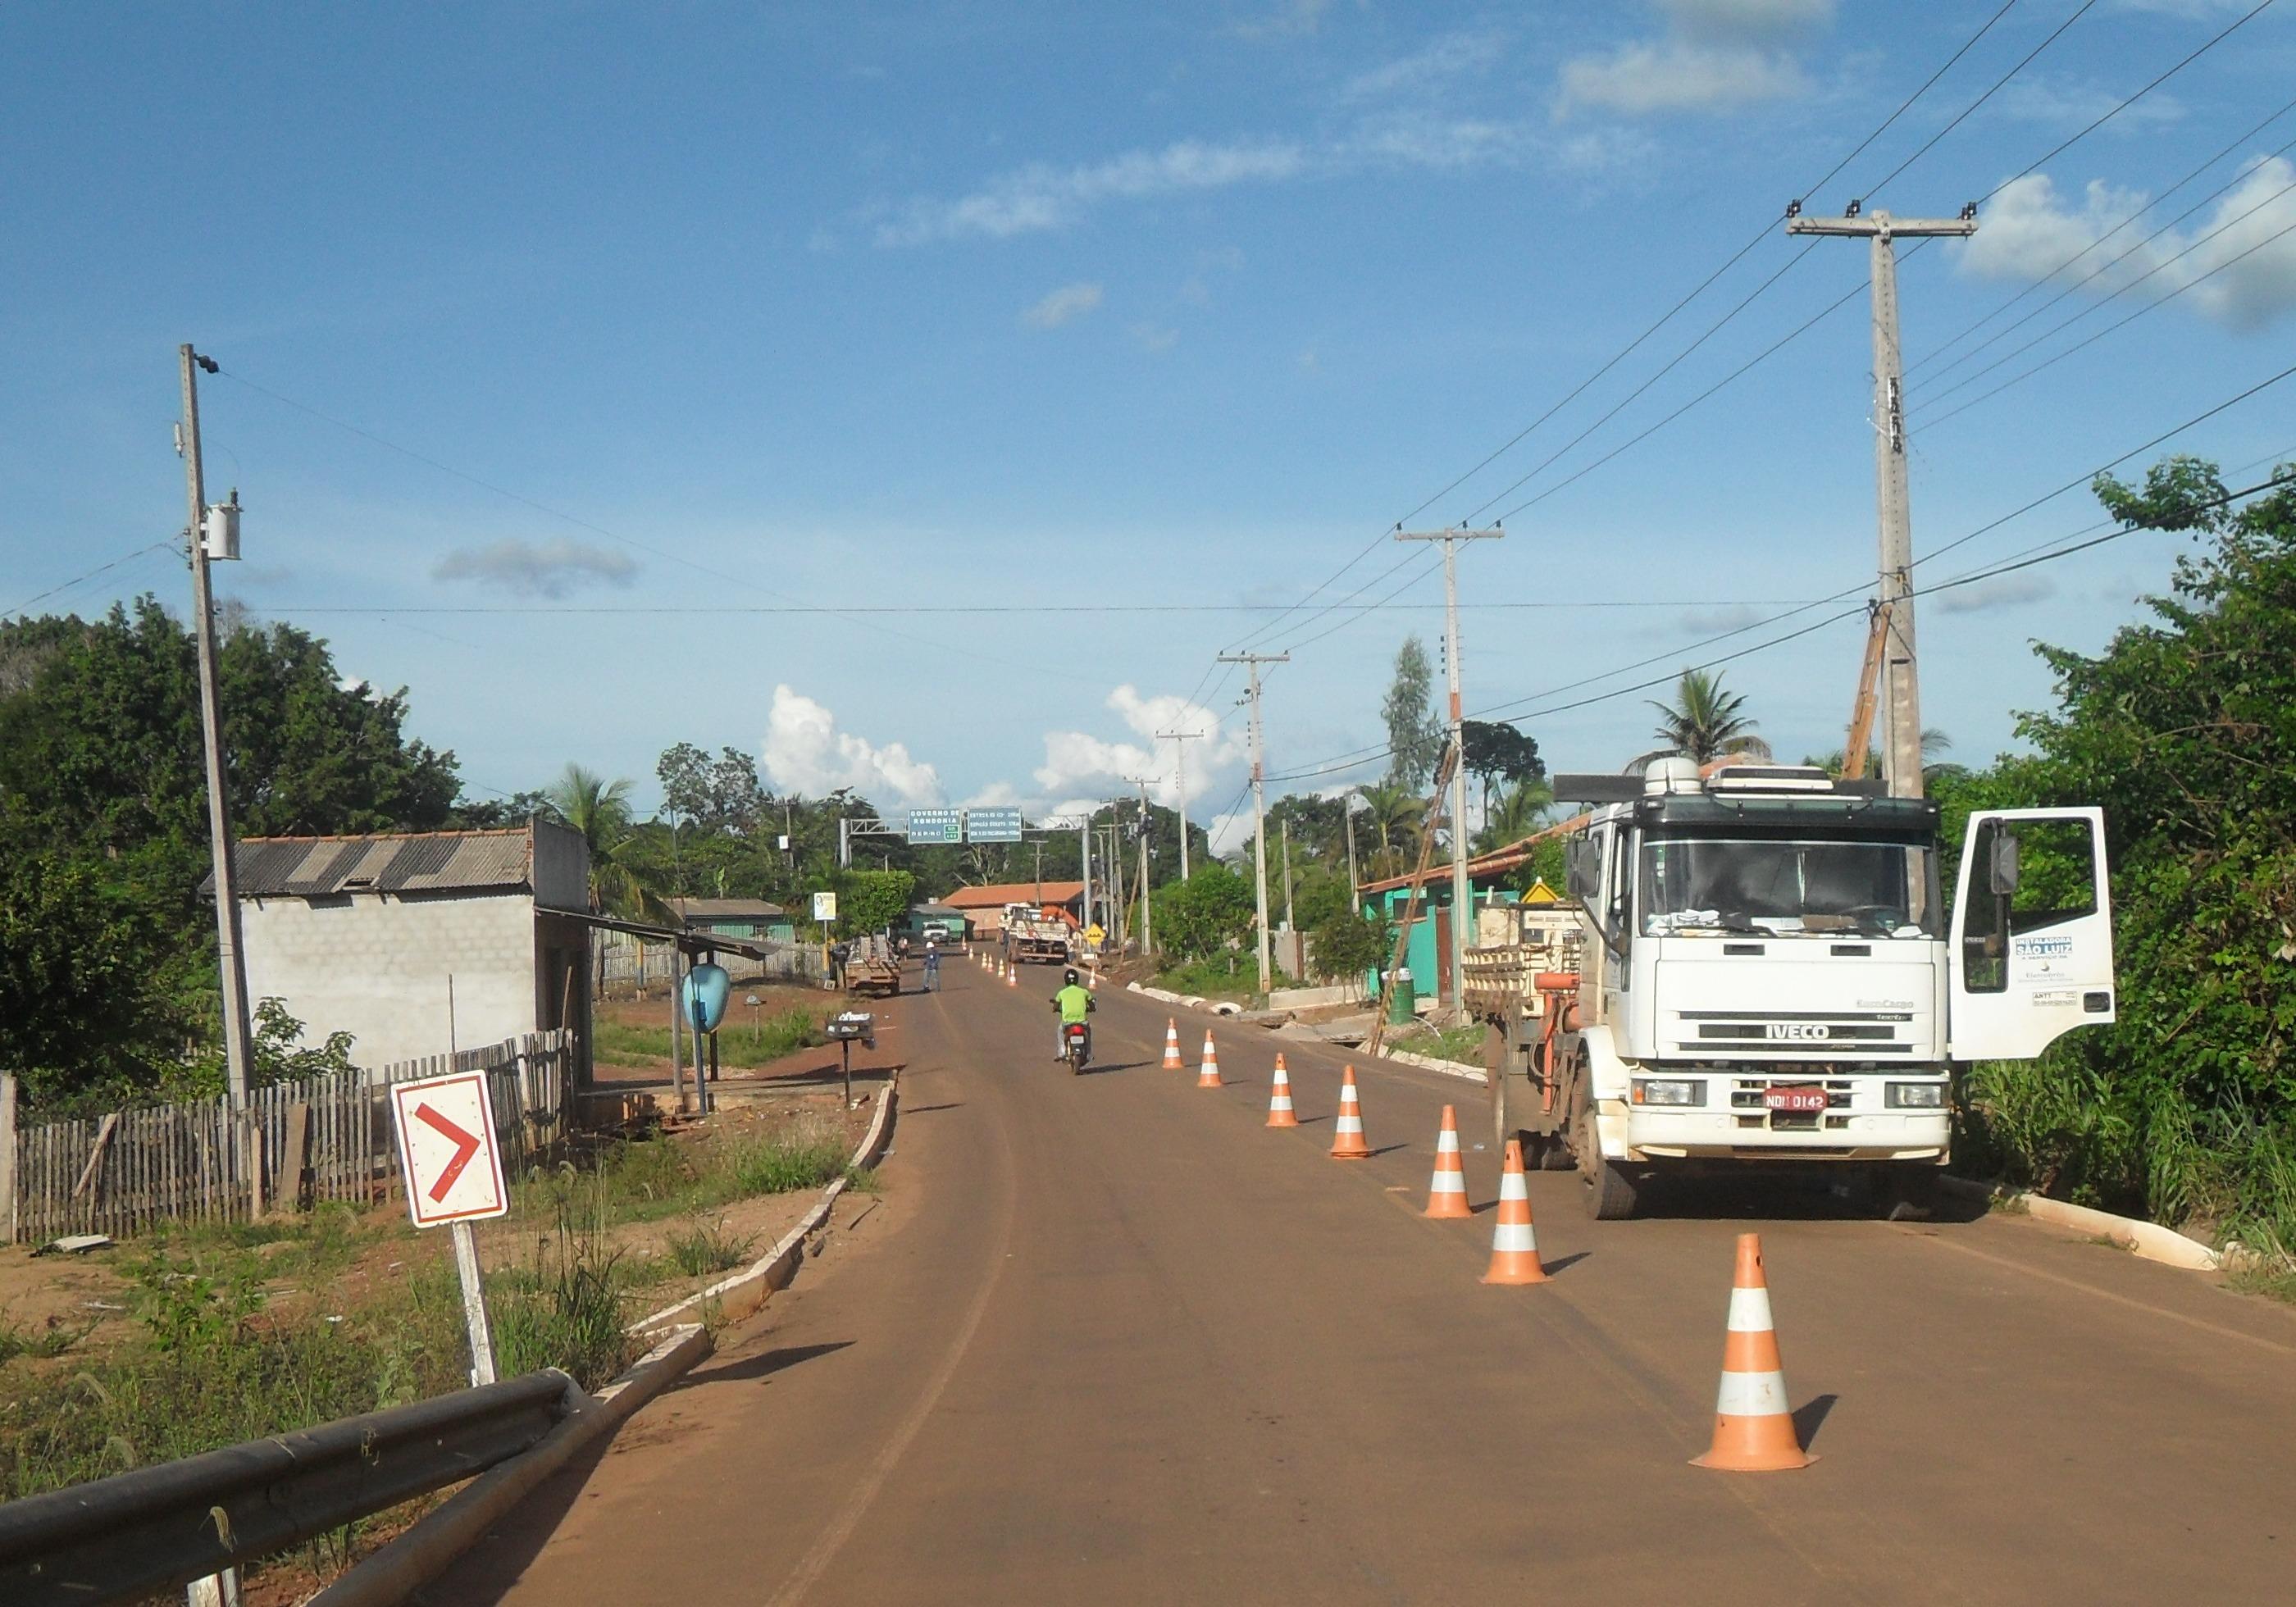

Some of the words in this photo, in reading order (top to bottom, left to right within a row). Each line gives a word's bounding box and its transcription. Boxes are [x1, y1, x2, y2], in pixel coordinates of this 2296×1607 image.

[2016, 936, 2071, 945] INSTALADORA
[2016, 943, 2043, 955] SÃO
[2043, 944, 2072, 954] LUIZ
[1765, 1024, 1829, 1040] IVECO
[1793, 1095, 1824, 1108] 0142
